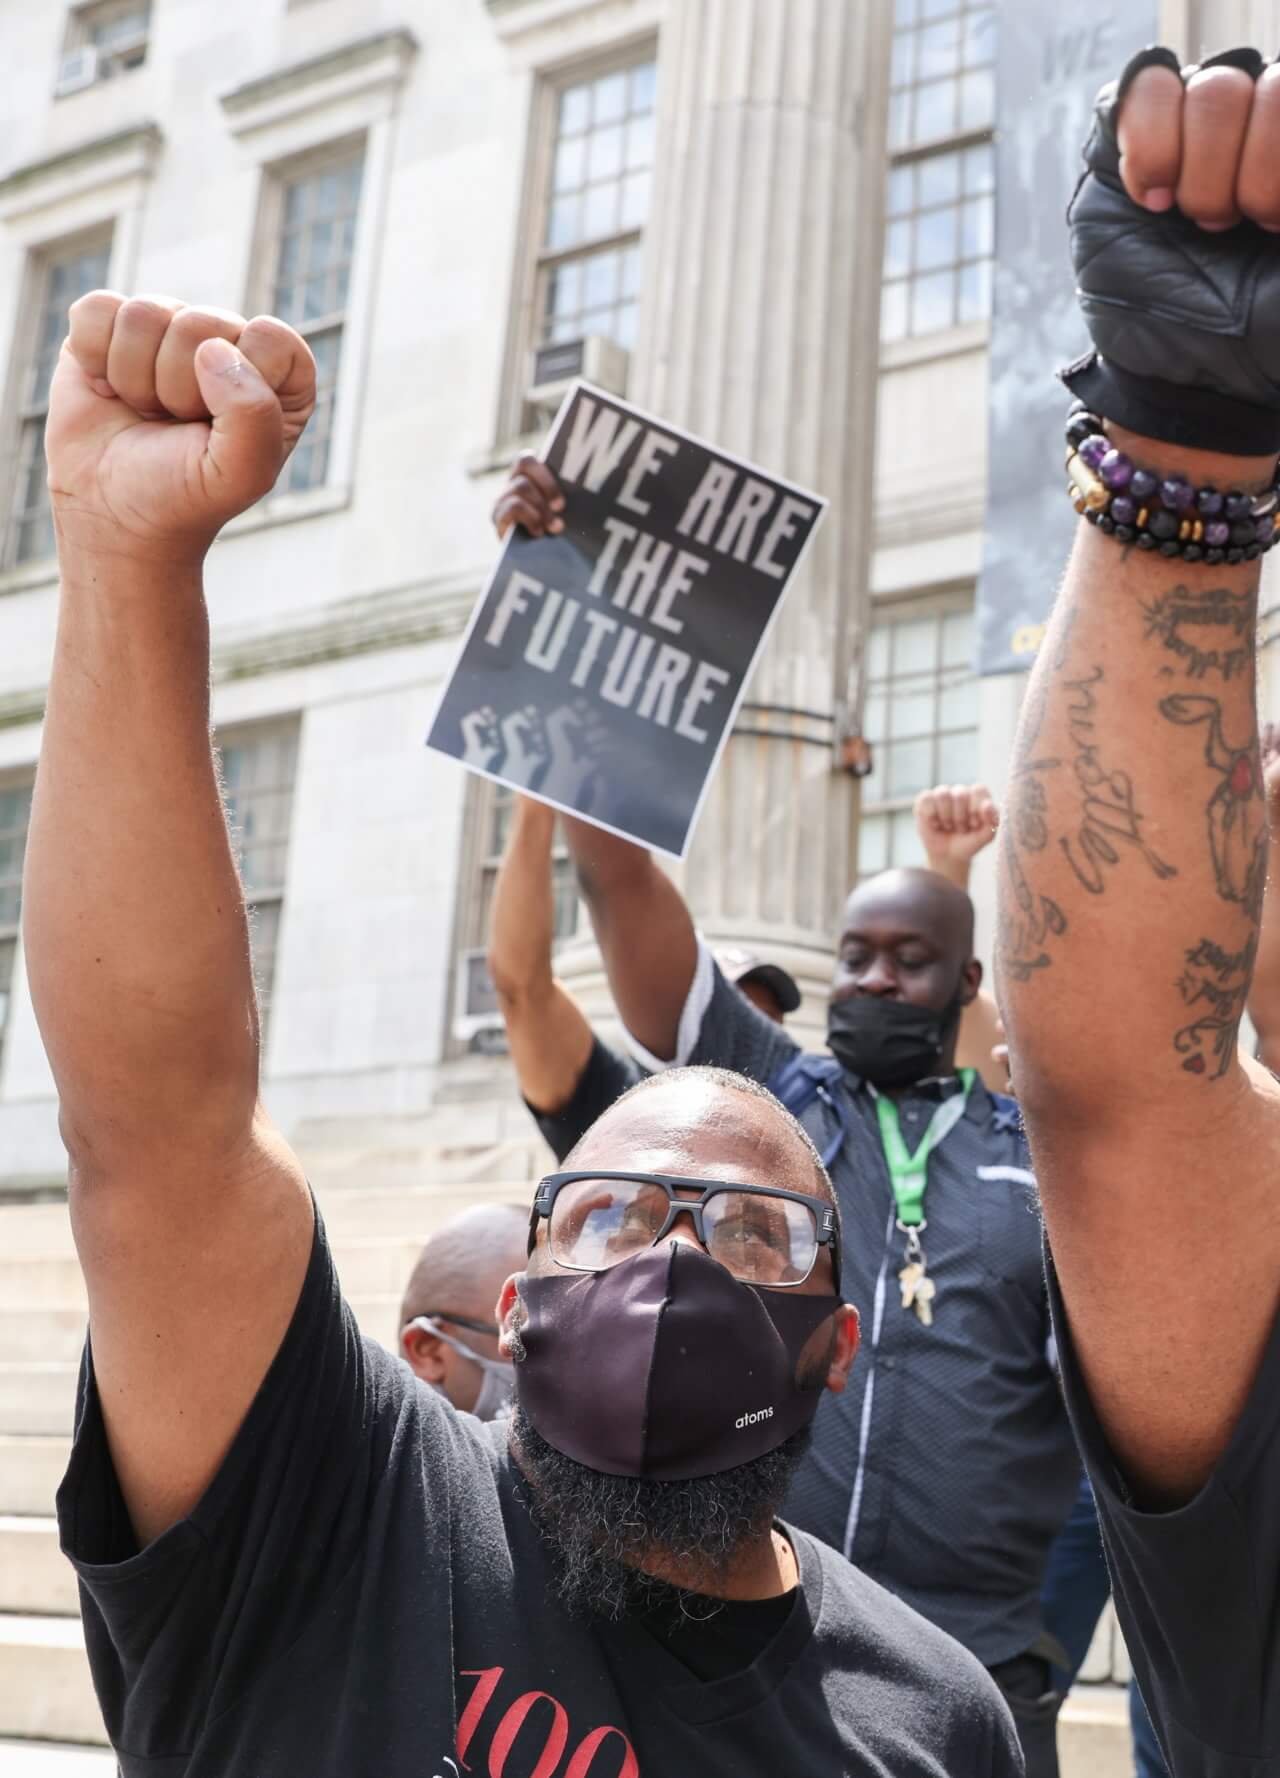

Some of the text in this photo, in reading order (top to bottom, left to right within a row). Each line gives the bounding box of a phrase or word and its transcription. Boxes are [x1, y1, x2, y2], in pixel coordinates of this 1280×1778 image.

[559, 397, 814, 580] WE ARE
[587, 517, 709, 635] THE
[484, 571, 730, 744] FUTURE
[735, 1406, 774, 1429] atoms
